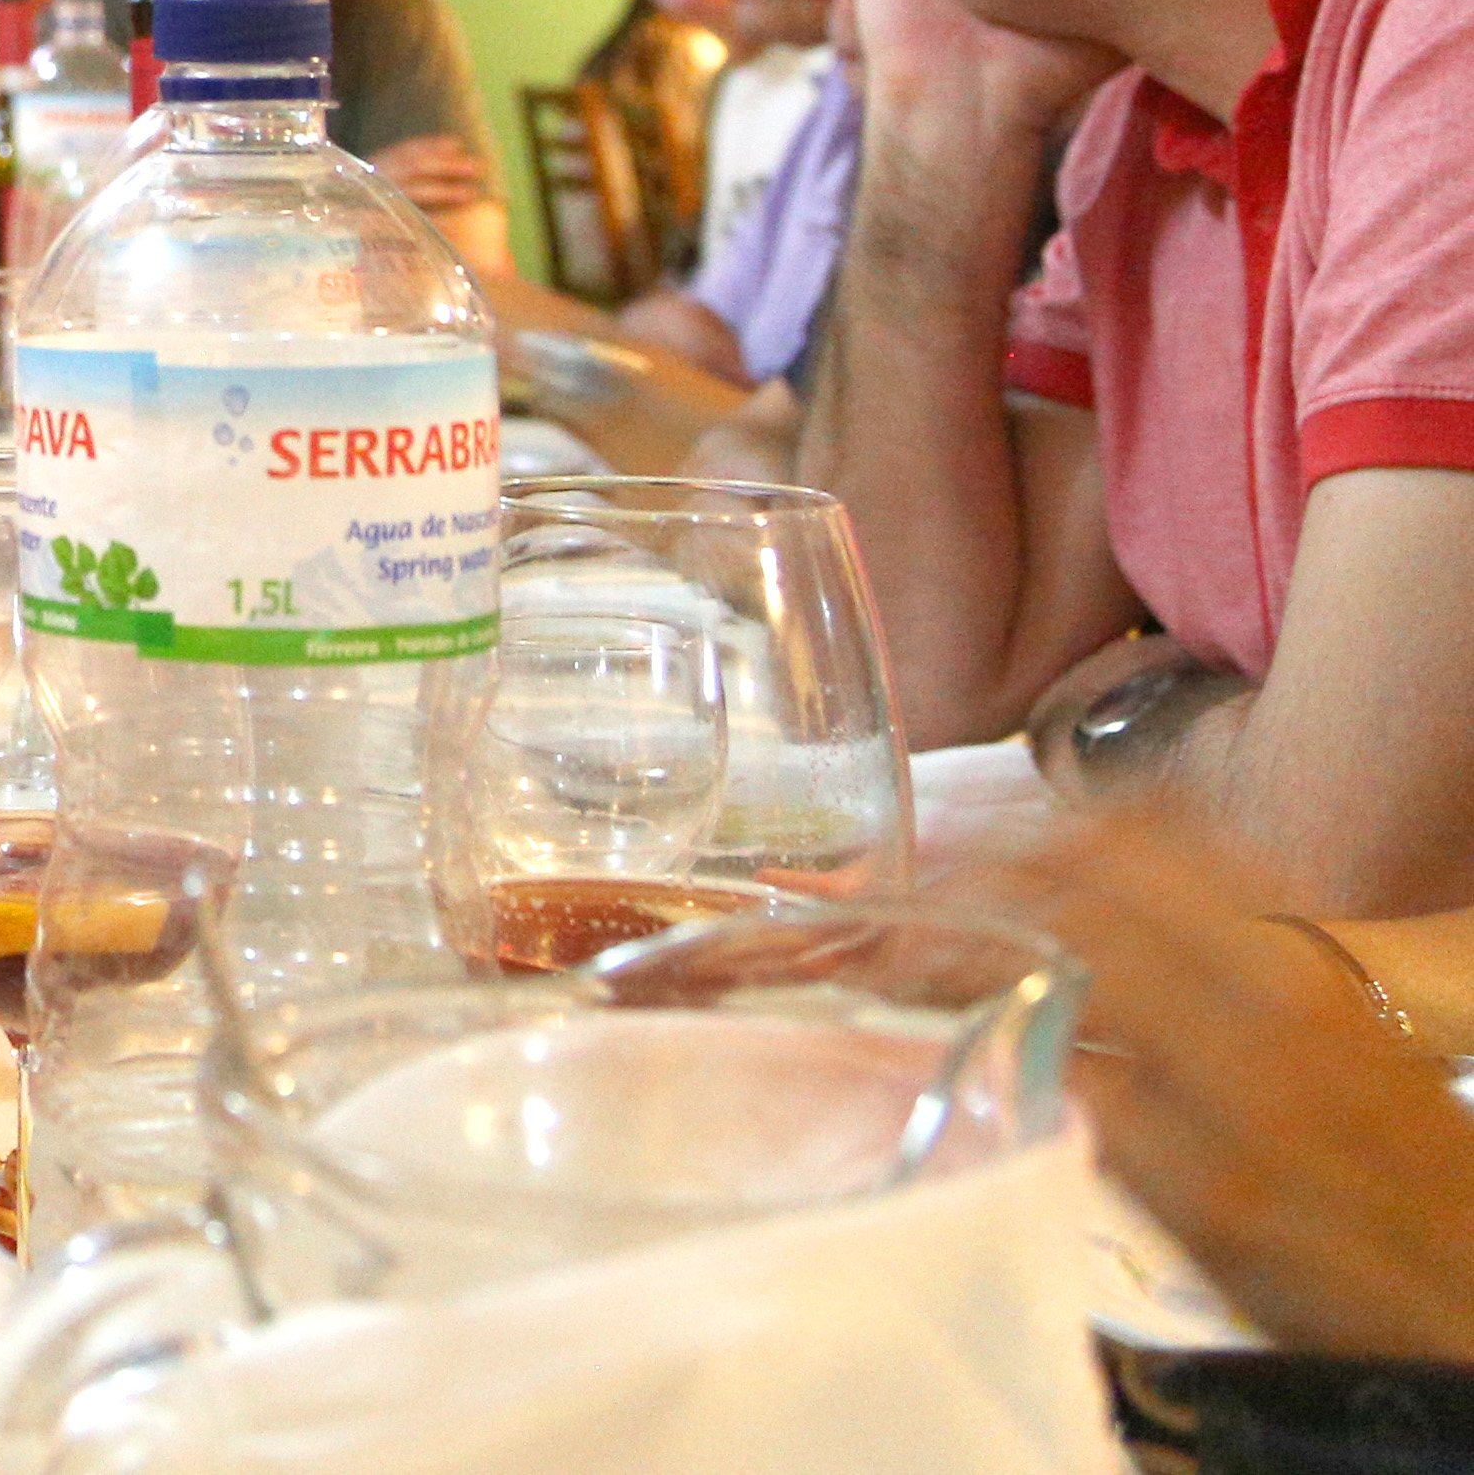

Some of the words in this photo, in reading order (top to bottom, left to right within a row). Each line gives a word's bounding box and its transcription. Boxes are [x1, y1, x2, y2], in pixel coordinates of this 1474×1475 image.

[345, 519, 413, 549] Agua
[421, 513, 447, 538] de
[378, 553, 453, 584] Spring
[227, 578, 302, 622] 1,5L
